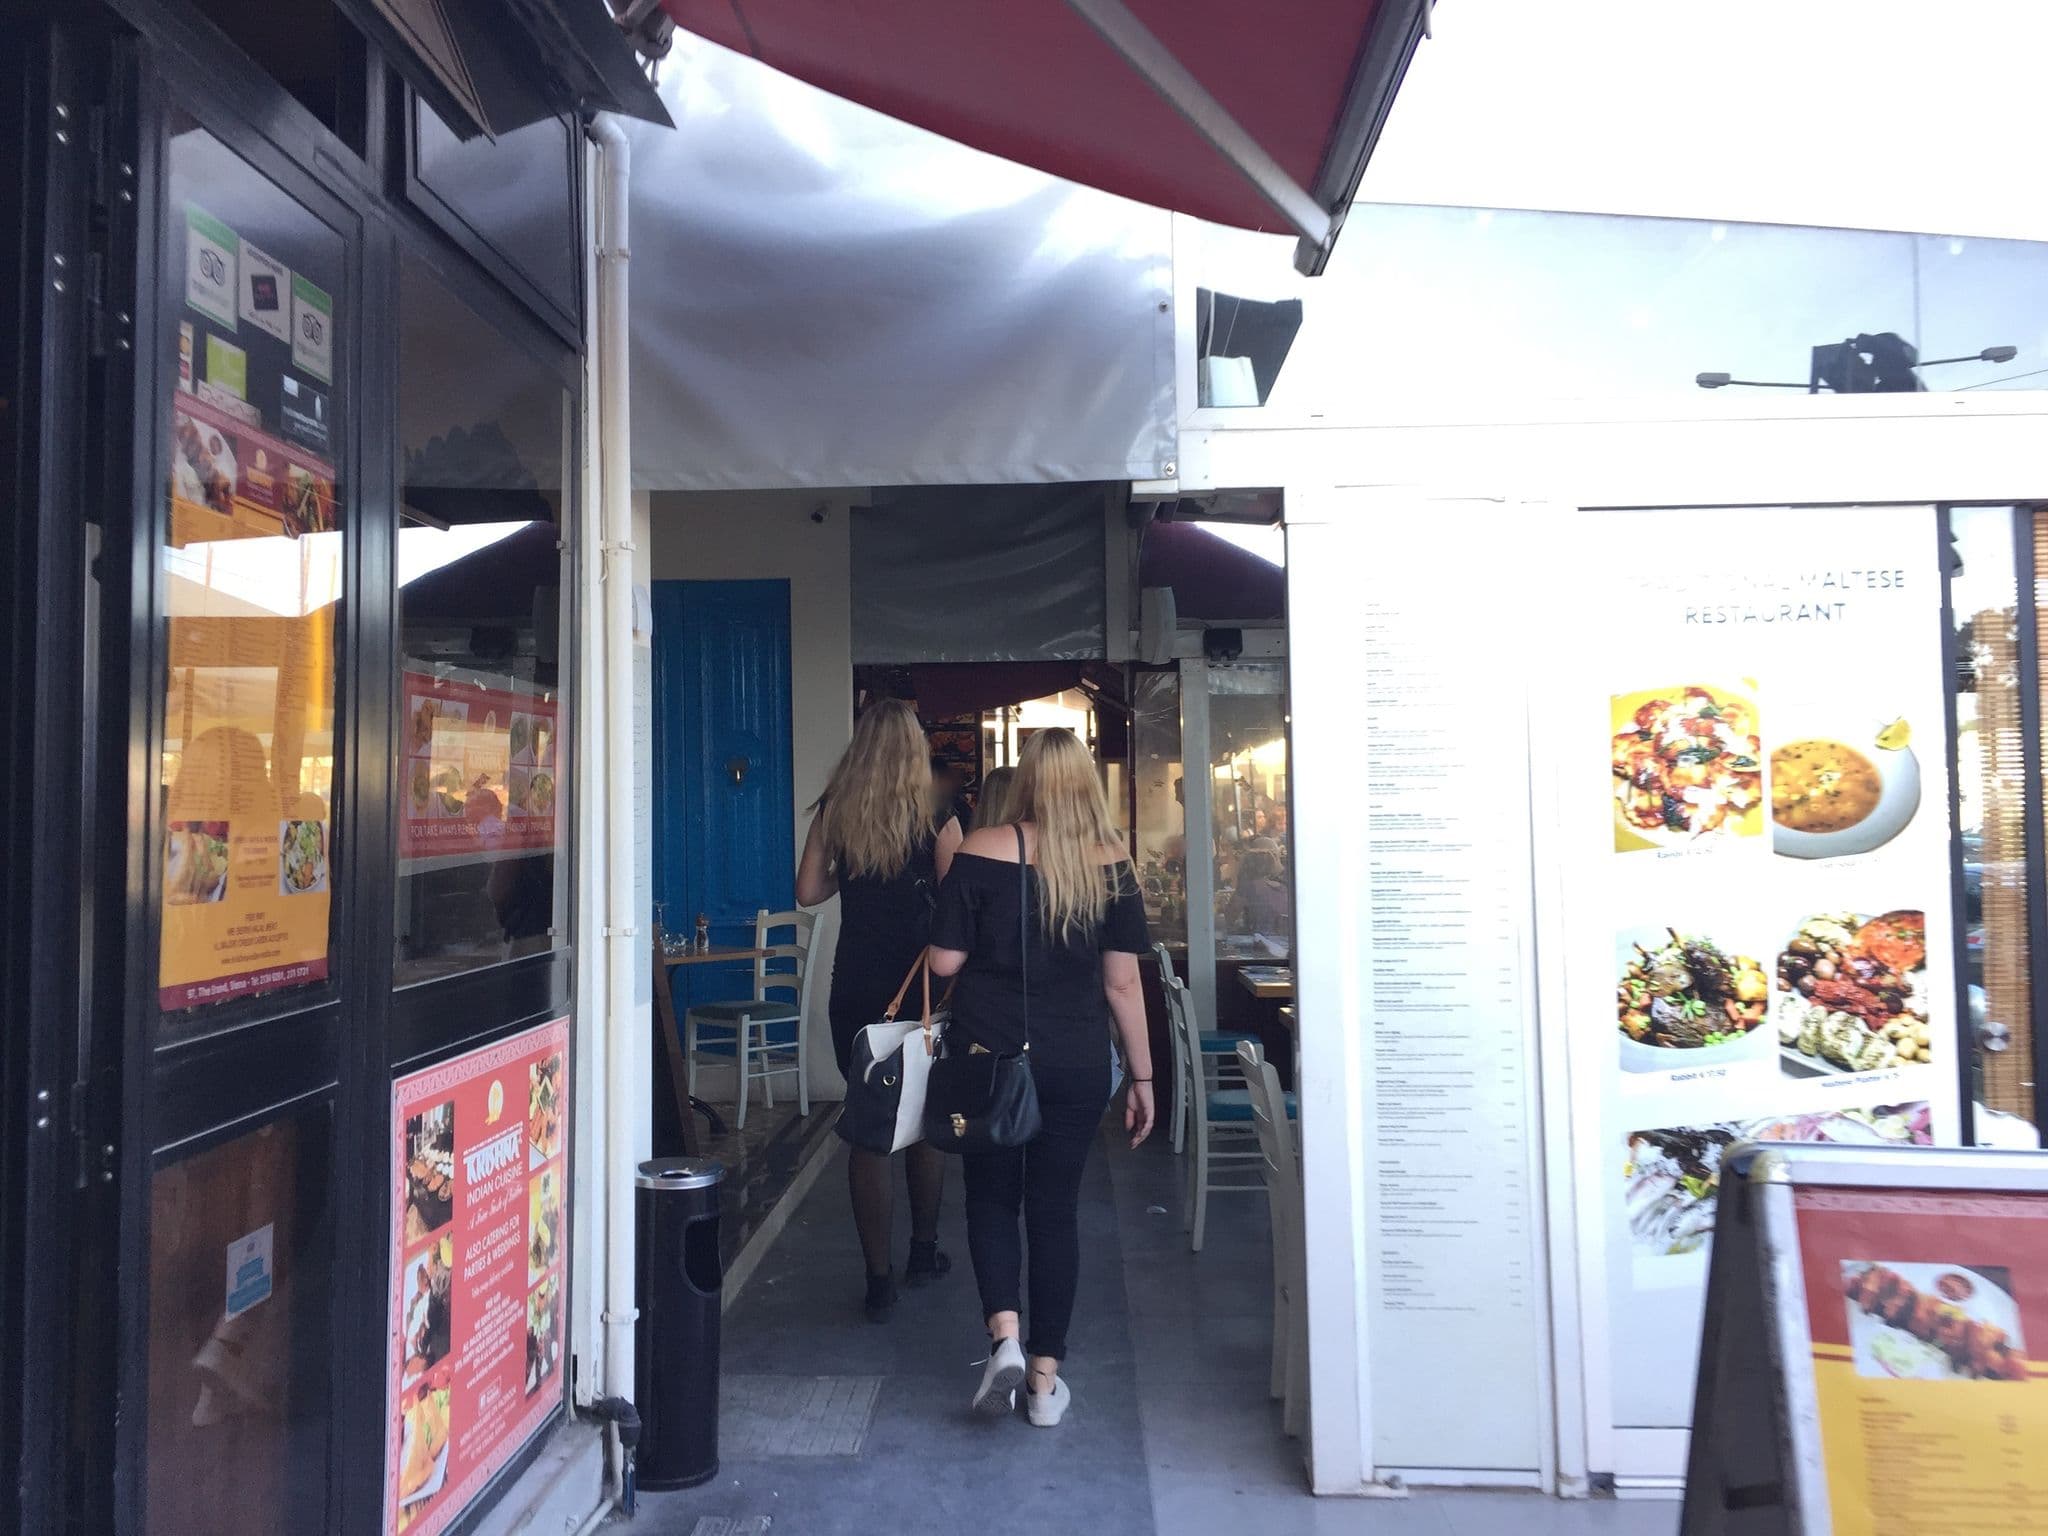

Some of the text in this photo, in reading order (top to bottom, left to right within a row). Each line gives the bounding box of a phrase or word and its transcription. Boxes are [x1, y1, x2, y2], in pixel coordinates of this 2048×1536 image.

[1685, 602, 1846, 624] RESTAURANT
[467, 1161, 523, 1208] INDIAN CUISINE
[465, 1240, 481, 1262] ALSO
